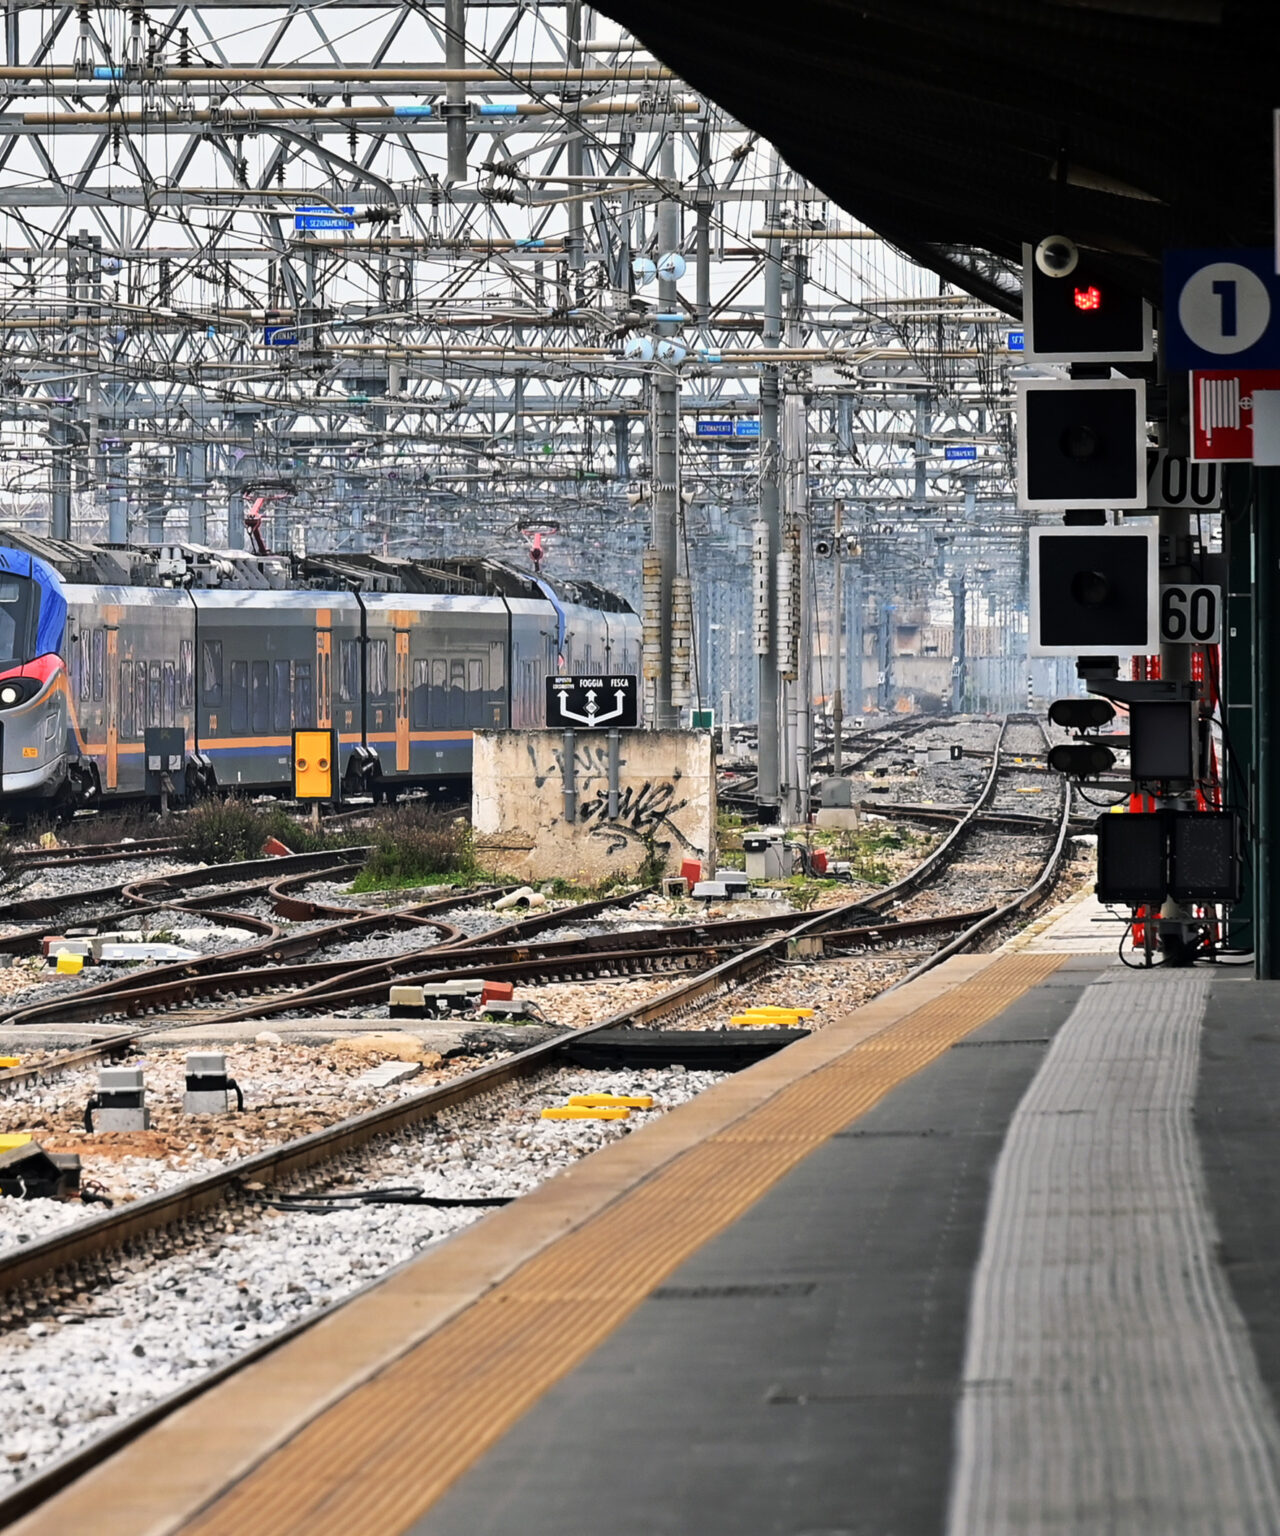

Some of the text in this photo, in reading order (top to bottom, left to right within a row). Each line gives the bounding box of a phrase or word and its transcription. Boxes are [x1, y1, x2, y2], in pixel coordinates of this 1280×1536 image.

[1212, 280, 1237, 337] 1
[1161, 587, 1216, 641] 60
[579, 678, 629, 688] FOGGIA FESCA
